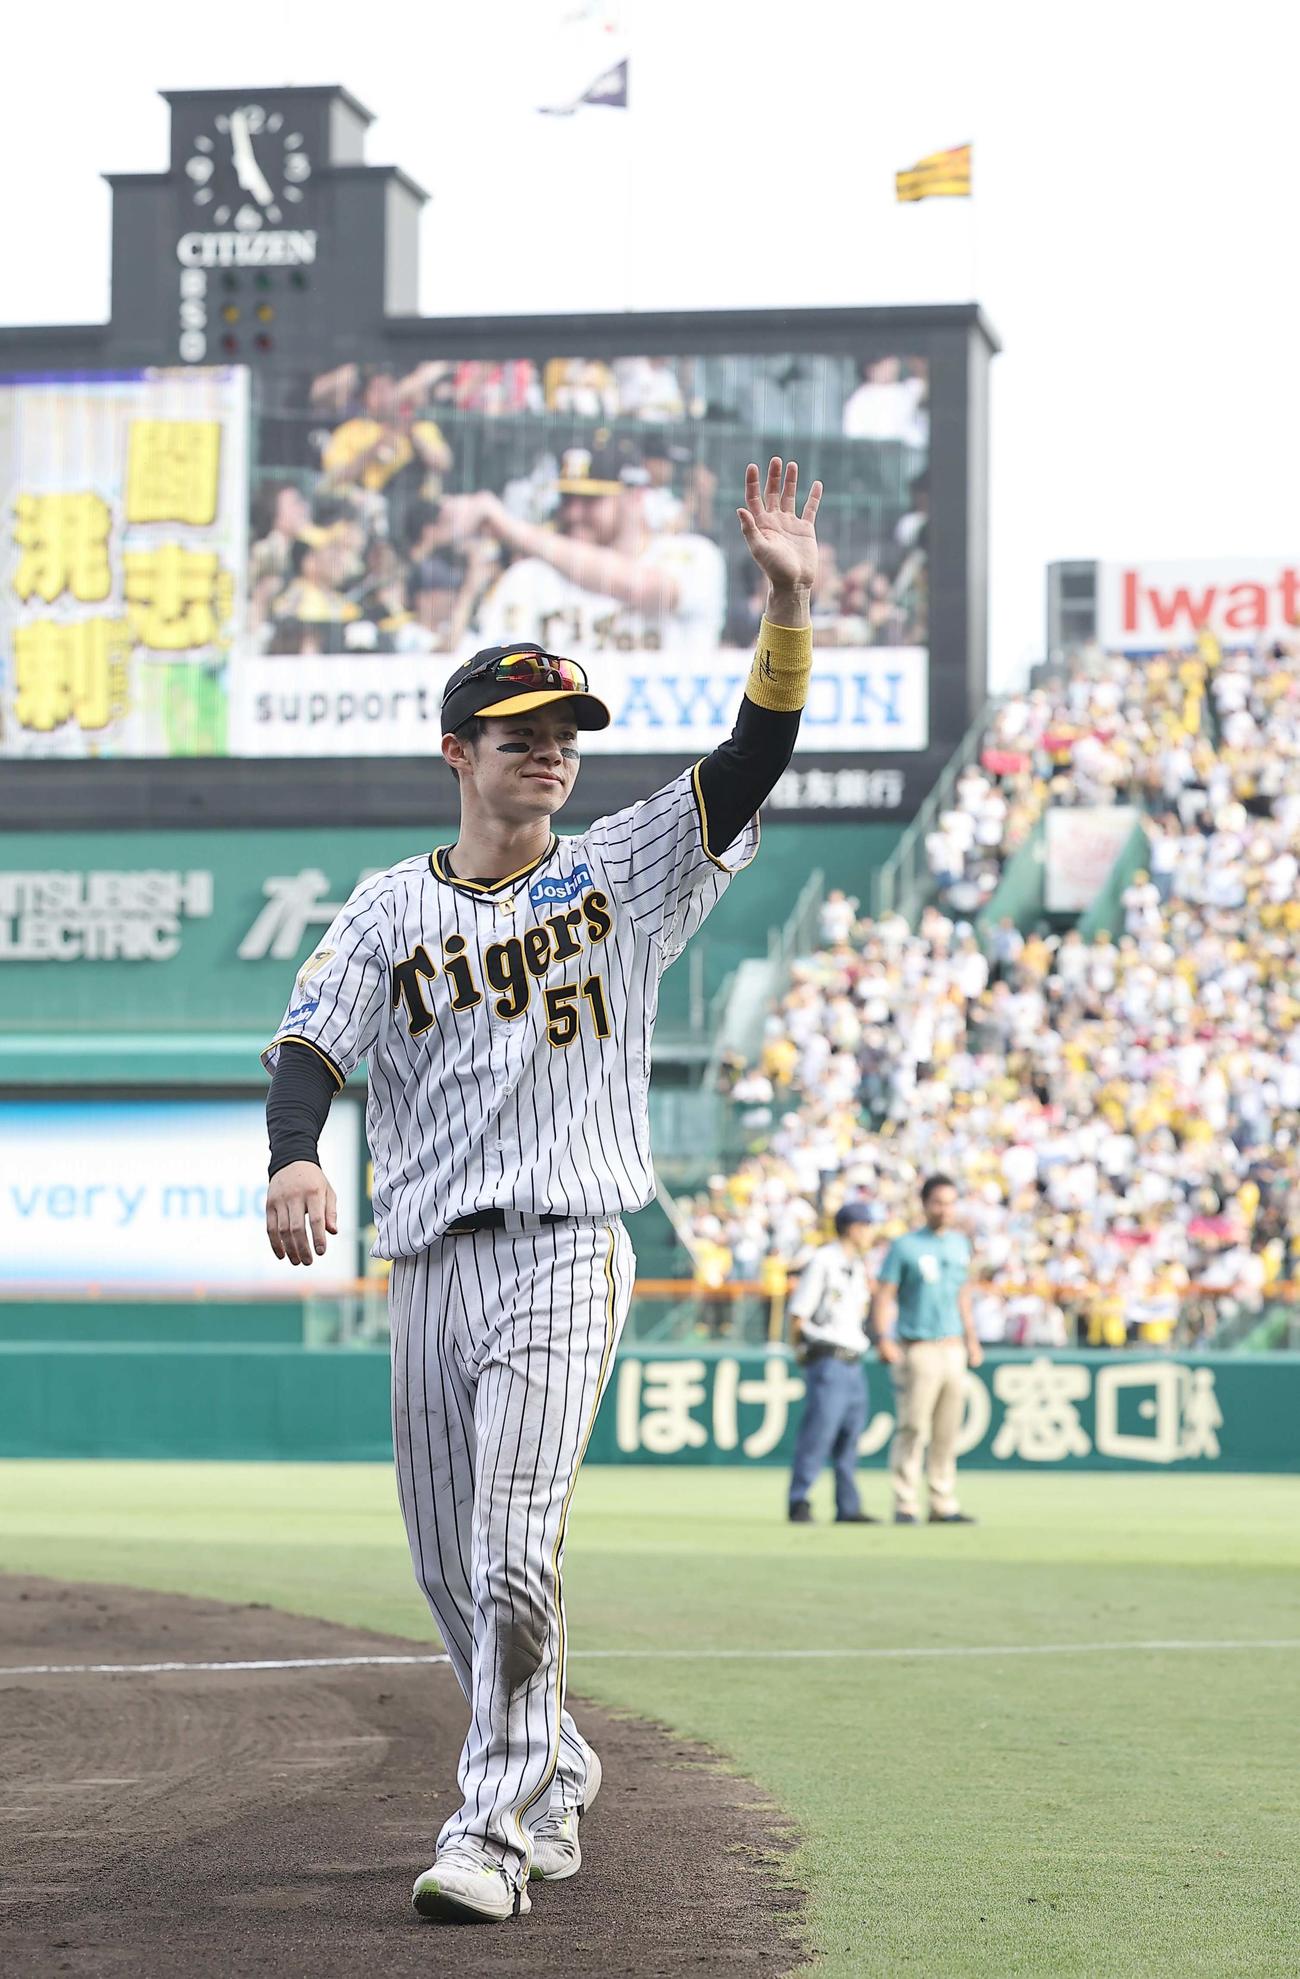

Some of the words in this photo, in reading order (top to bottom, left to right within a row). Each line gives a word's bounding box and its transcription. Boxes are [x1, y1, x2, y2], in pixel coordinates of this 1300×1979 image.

[177, 230, 317, 268] CITIZEN
[1121, 569, 1300, 634] Iwat
[255, 683, 442, 727] support
[612, 672, 904, 728] AWON
[530, 867, 592, 902] Joshin
[392, 889, 614, 1037] Tigers
[542, 974, 613, 1050] 51
[9, 1182, 147, 1228] very
[160, 1183, 268, 1220] muc
[616, 1356, 1190, 1463] ほけ窓口
